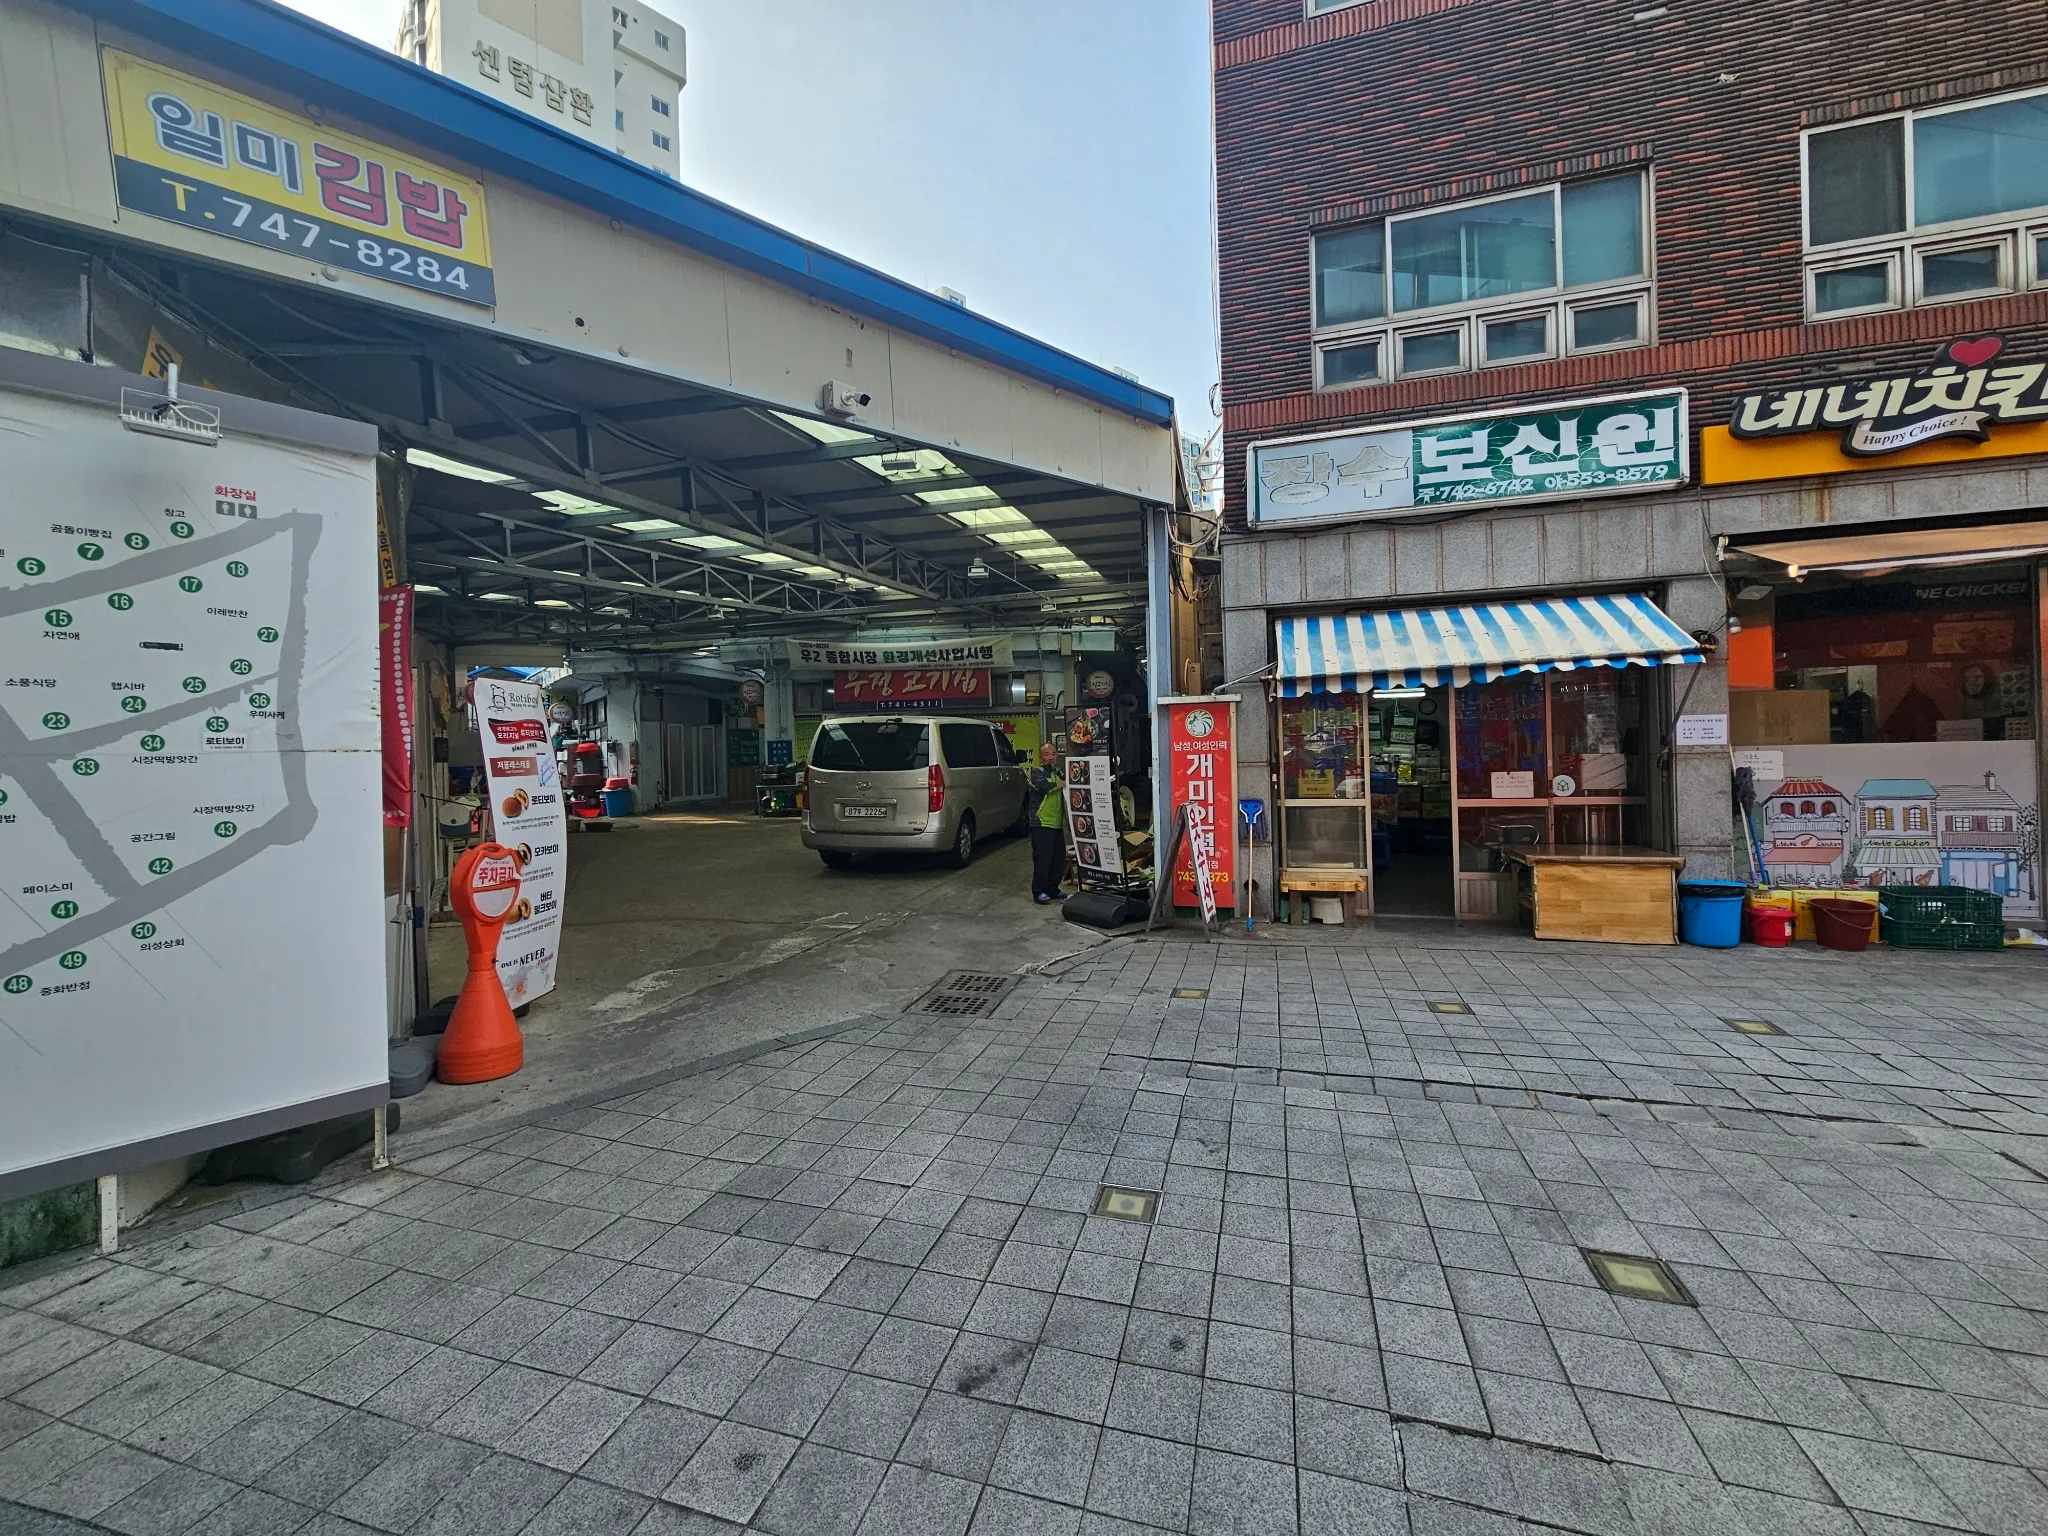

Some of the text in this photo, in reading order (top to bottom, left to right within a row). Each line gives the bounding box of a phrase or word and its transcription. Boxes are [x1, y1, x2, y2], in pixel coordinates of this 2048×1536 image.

[472, 40, 594, 126] 센텀삼환
[145, 92, 468, 250] 일미김밥
[161, 177, 470, 290] T.747-8284
[1738, 362, 2048, 433] 네네치킨
[1417, 404, 1679, 482] 보신원
[1863, 433, 1906, 446] Happy
[215, 485, 257, 501] 화장실
[164, 507, 187, 518] 창고
[175, 522, 190, 537] 9
[129, 533, 144, 549] 8
[82, 543, 99, 559] 7
[24, 559, 39, 575] 6
[229, 561, 246, 577] 18
[182, 577, 199, 592] 17
[111, 594, 130, 610] 16
[48, 610, 69, 626] 15
[207, 606, 248, 619] 이레반찬
[42, 630, 81, 641] 자연애
[259, 628, 276, 642] 27
[825, 650, 878, 664] 종합시장
[233, 660, 250, 674] 26
[4, 677, 58, 689] 소풍식당
[186, 678, 204, 693] 25
[124, 697, 143, 712] 24
[252, 694, 268, 708] 36
[46, 713, 67, 729] 23
[209, 717, 227, 732] 35
[143, 736, 162, 750] 34
[205, 736, 245, 746] 로티보이
[1173, 740, 1228, 752] 남성,여성인력
[76, 759, 96, 774] 33
[130, 831, 176, 843] 공간그림
[218, 822, 234, 837] 43
[533, 843, 559, 857] 모카보이
[152, 859, 170, 874] 42
[478, 865, 514, 885] 주차금지
[22, 882, 74, 895] 페이스미
[56, 902, 75, 917] 41
[134, 923, 153, 937] 50
[140, 938, 185, 952] 의성상회
[63, 952, 83, 968] 49
[519, 947, 546, 967] NEVER
[7, 976, 29, 992] 48
[40, 981, 91, 997] 중화반점
